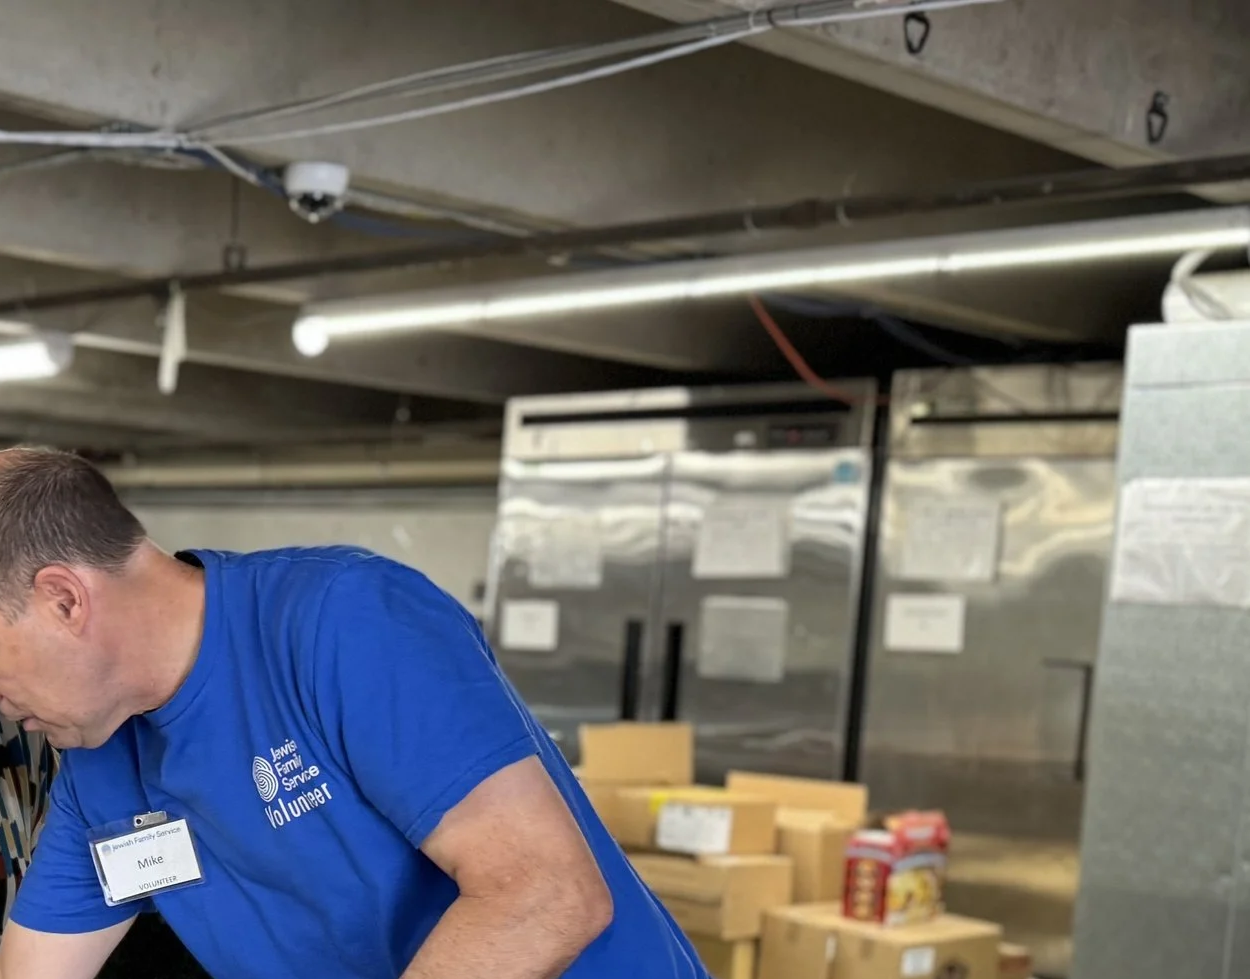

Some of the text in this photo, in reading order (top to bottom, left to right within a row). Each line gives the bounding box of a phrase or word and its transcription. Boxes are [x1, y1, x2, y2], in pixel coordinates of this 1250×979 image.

[281, 764, 320, 792] Service
[264, 782, 332, 829] Volunteer
[111, 826, 182, 852] Jewish Family Service
[137, 855, 164, 870] Mike
[138, 875, 177, 891] VOLUNTEER
